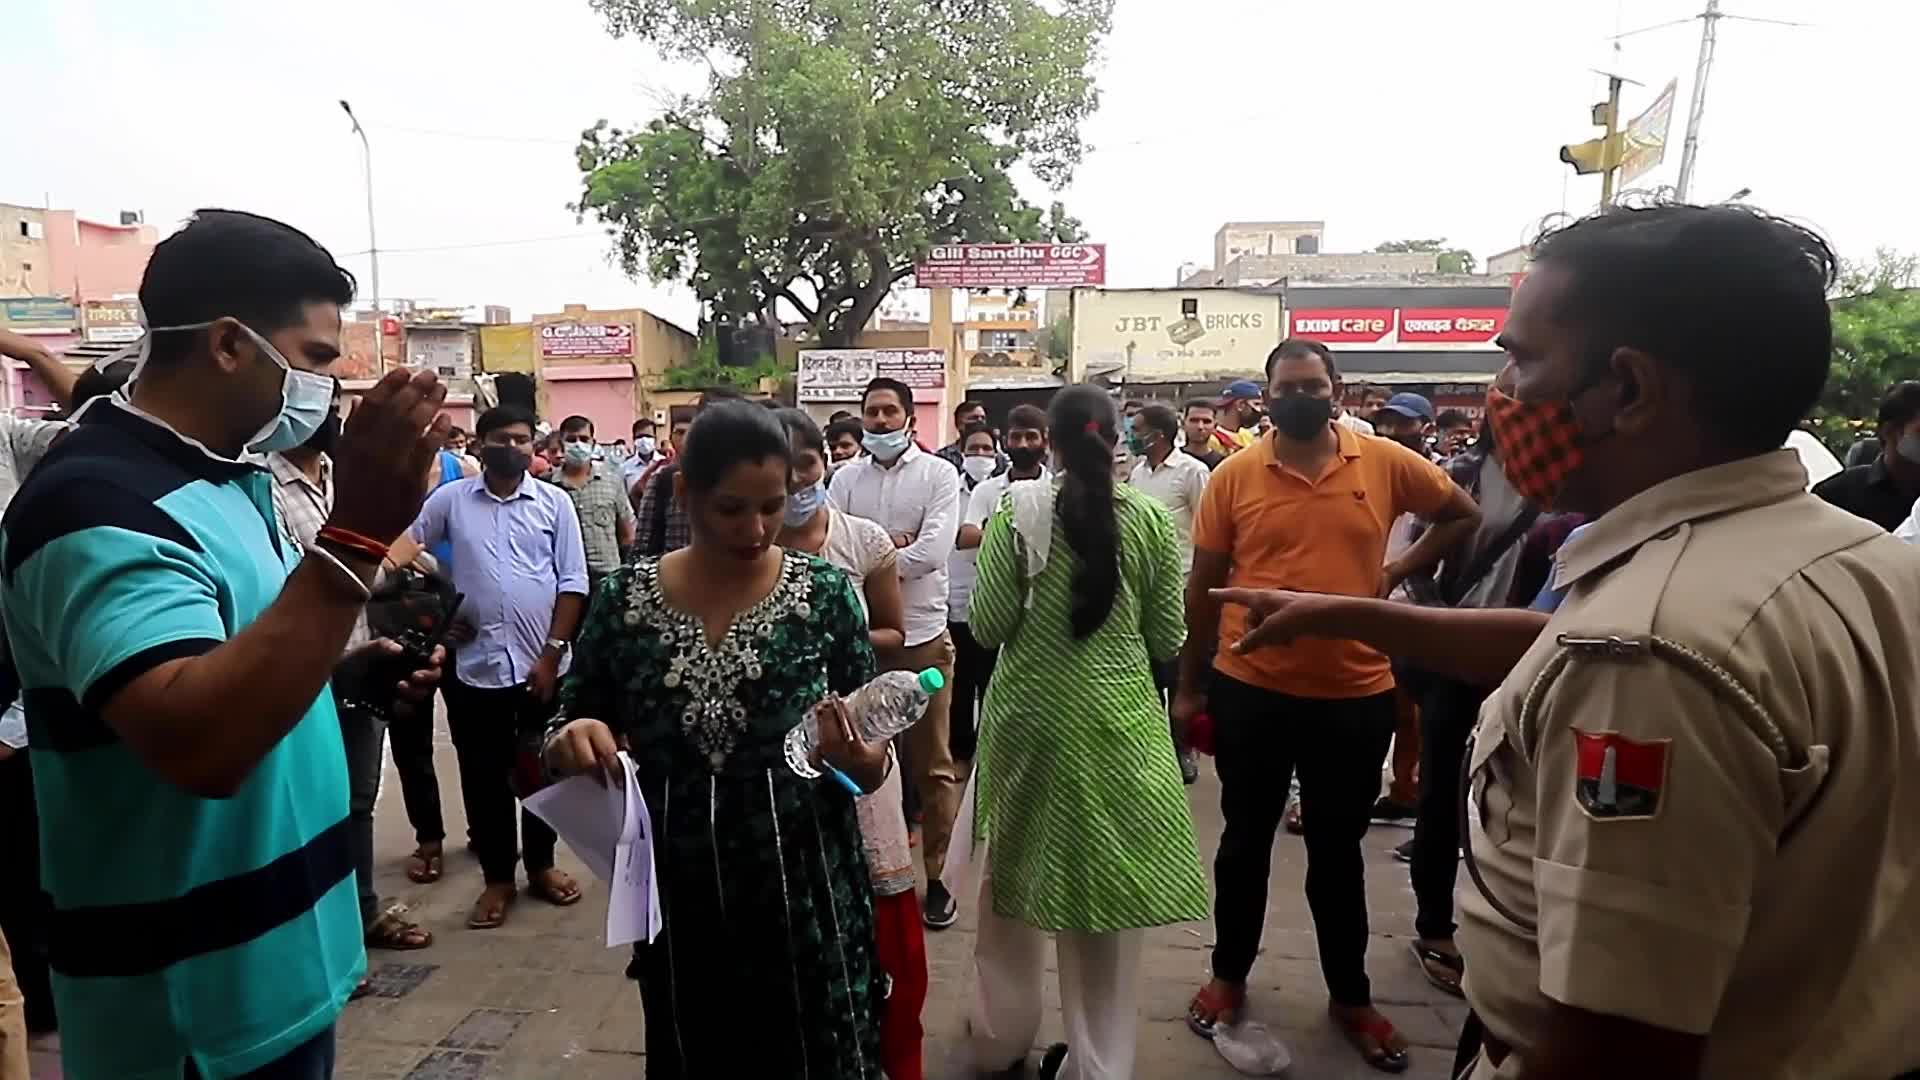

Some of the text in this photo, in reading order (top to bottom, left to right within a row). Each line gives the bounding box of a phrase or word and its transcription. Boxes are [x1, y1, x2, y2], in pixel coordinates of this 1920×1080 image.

[968, 246, 1045, 259] Sandhu
[1050, 247, 1082, 258] GGC
[1115, 313, 1263, 332] JBT BRICKS
[1295, 318, 1386, 333] EXIDE care
[904, 351, 945, 364] Sandhu
